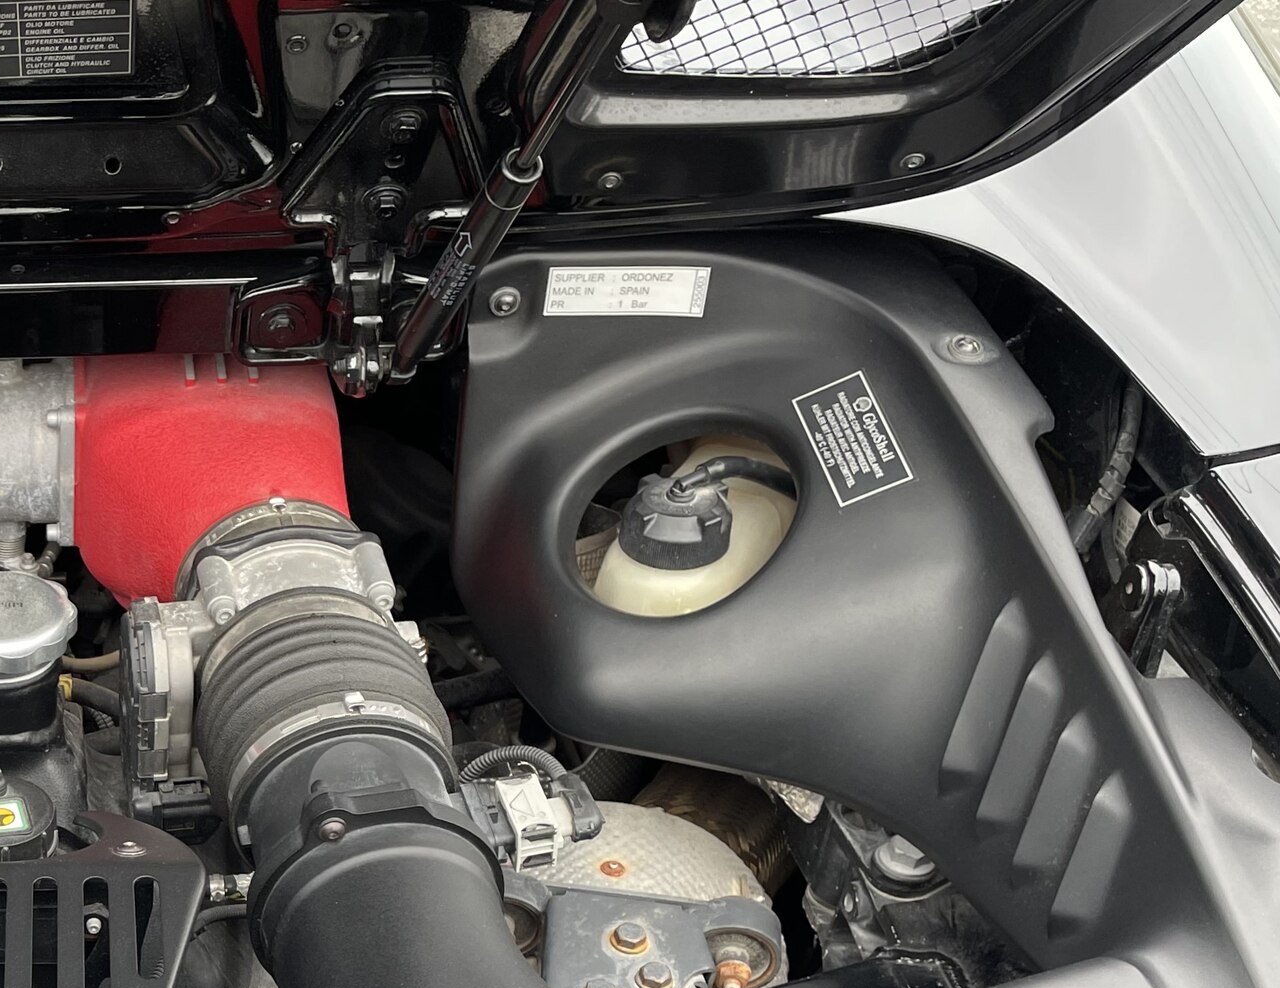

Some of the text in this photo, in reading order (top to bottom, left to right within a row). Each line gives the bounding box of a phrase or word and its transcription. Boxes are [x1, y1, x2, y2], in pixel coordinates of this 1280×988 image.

[58, 2, 105, 10] LUBRIFICARE
[72, 8, 116, 16] LUBRICATED
[25, 37, 78, 45] DIFFERENZIALE
[26, 45, 59, 53] GEARBOX
[554, 273, 605, 283] SUPPLIER
[621, 272, 673, 282] ORDONEZ
[552, 287, 581, 296] MADE
[584, 287, 594, 296] IN
[619, 287, 649, 295] SPAIN
[550, 301, 564, 309] PR
[631, 300, 648, 309] Bar
[862, 412, 895, 463] GlycoShell
